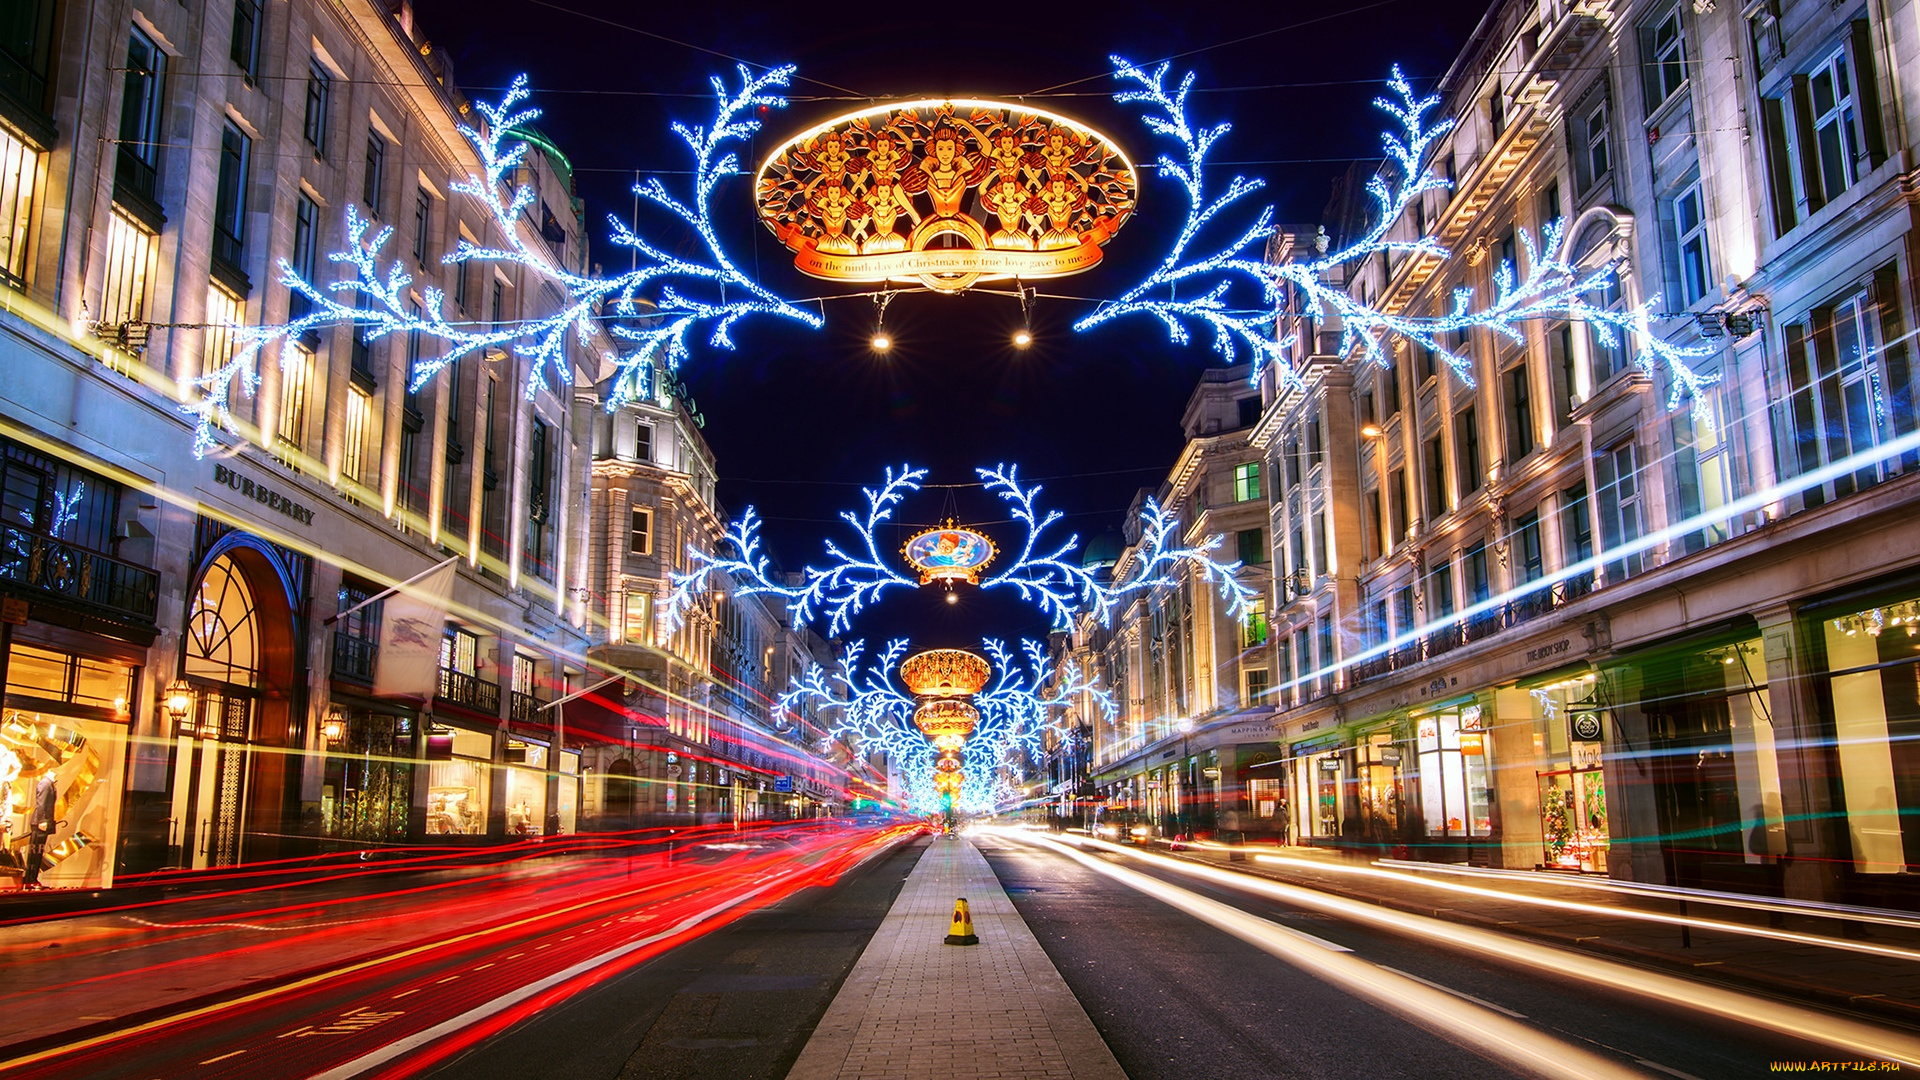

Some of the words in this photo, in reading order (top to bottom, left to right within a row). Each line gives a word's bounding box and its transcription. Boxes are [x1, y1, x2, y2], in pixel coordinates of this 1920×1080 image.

[809, 259, 822, 268] on
[825, 261, 842, 271] the
[845, 262, 871, 272] ninth
[874, 262, 891, 274] day
[895, 260, 905, 269] of
[908, 257, 960, 268] Christmas
[963, 259, 978, 269] my
[981, 258, 1002, 267] true
[1005, 256, 1024, 267] love
[1029, 259, 1052, 269] gave
[1055, 257, 1065, 266] to
[1067, 254, 1094, 264] me...
[214, 463, 316, 526] BURBERRY
[1526, 649, 1540, 662] THE
[1539, 644, 1553, 659] BODY
[1231, 726, 1258, 734] MAPPIN
[1580, 724, 1596, 732] BODY
